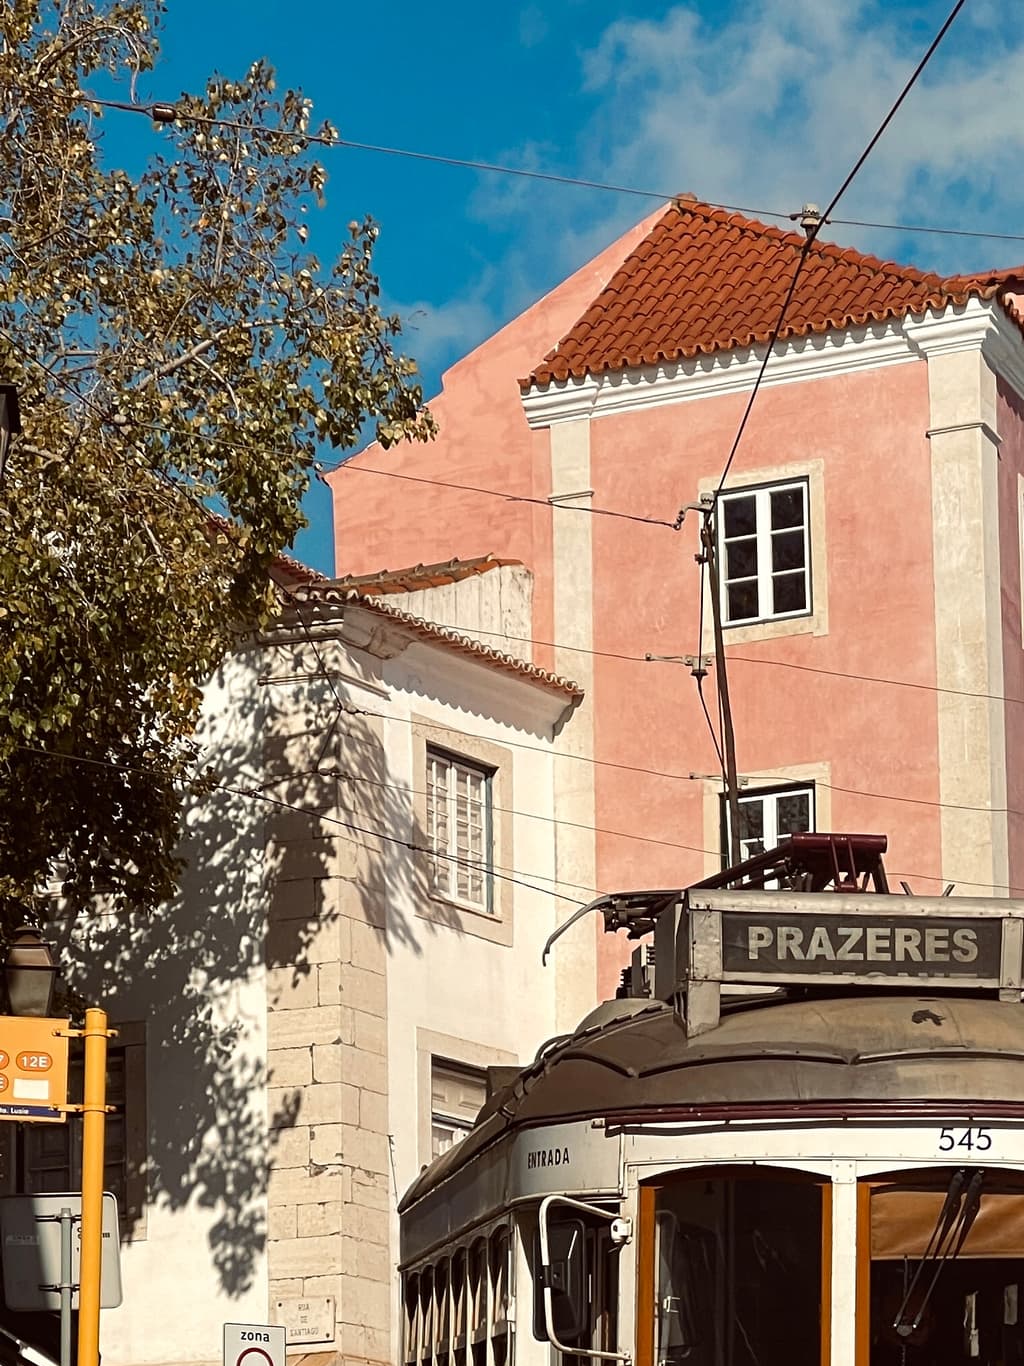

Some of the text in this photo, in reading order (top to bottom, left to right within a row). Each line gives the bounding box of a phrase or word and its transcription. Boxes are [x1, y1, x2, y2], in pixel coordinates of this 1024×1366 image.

[748, 926, 979, 962] PRAZERES
[21, 1056, 48, 1068] 12E
[939, 1127, 992, 1151] 545
[527, 1147, 570, 1169] ENTRADA
[240, 1331, 270, 1342] zona
